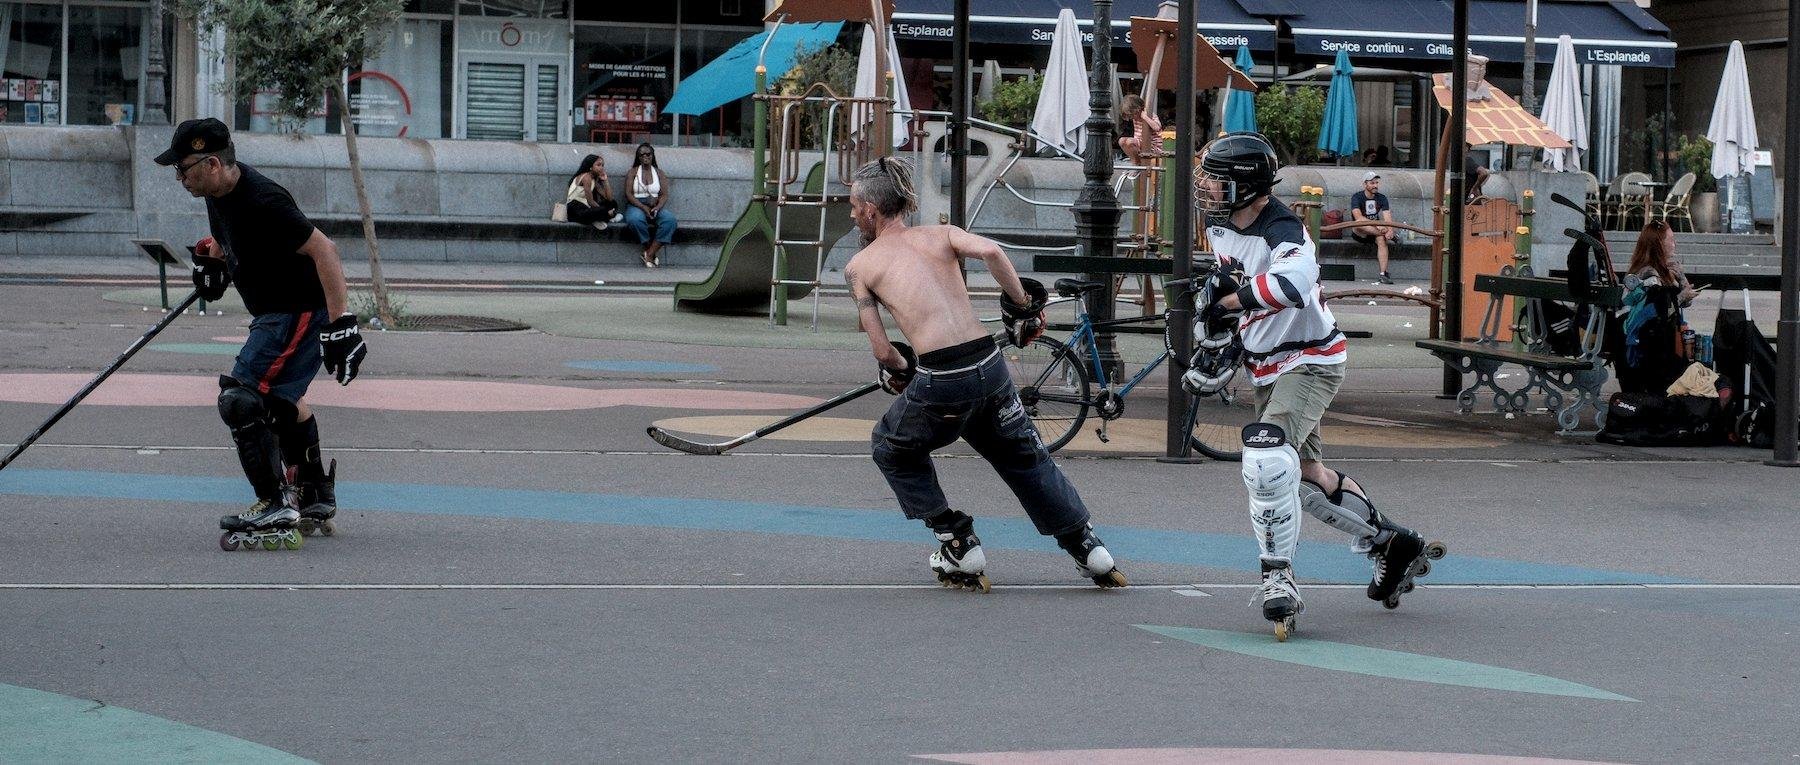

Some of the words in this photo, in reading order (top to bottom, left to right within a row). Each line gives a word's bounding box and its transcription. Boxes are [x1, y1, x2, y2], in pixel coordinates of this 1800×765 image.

[889, 23, 954, 37] L'Esplanad
[1203, 34, 1249, 46] rasserie
[1320, 39, 1360, 52] Service
[1366, 41, 1404, 53] continu
[1587, 49, 1651, 63] L'Esplanade
[319, 324, 358, 341] CCM
[1245, 435, 1281, 444] JOFA
